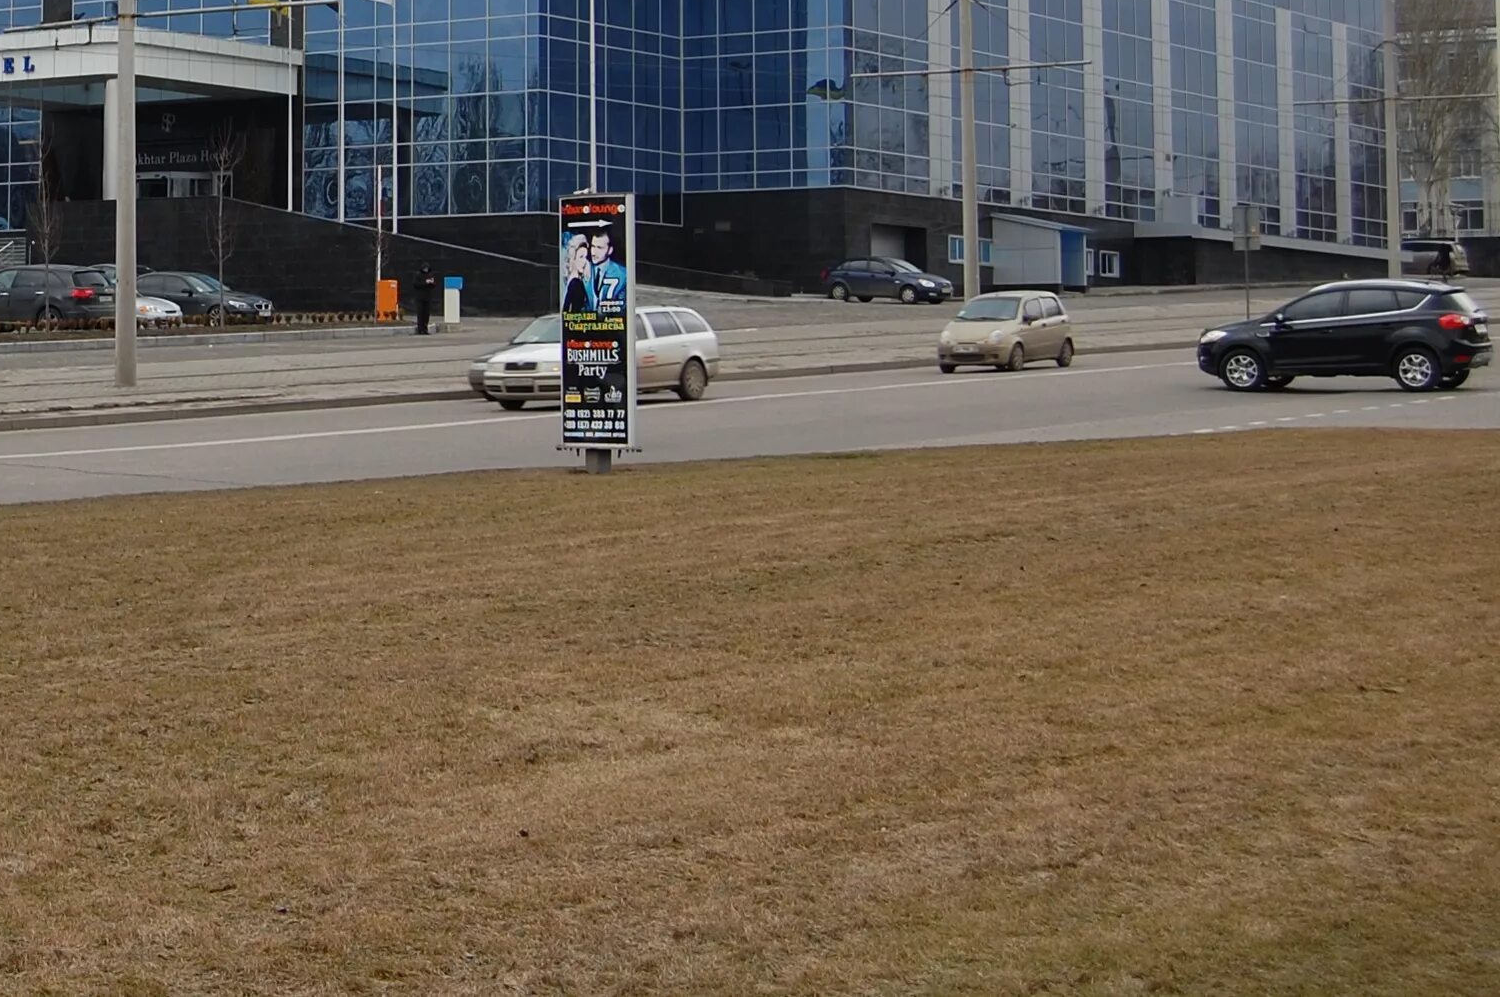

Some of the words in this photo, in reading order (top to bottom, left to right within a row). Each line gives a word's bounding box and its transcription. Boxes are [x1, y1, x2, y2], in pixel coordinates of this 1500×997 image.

[169, 151, 197, 164] Plaza
[603, 278, 619, 299] 7
[567, 348, 619, 362] BUSHMILLS
[578, 364, 607, 379] Party
[606, 409, 615, 419] 77
[615, 409, 626, 419] 77
